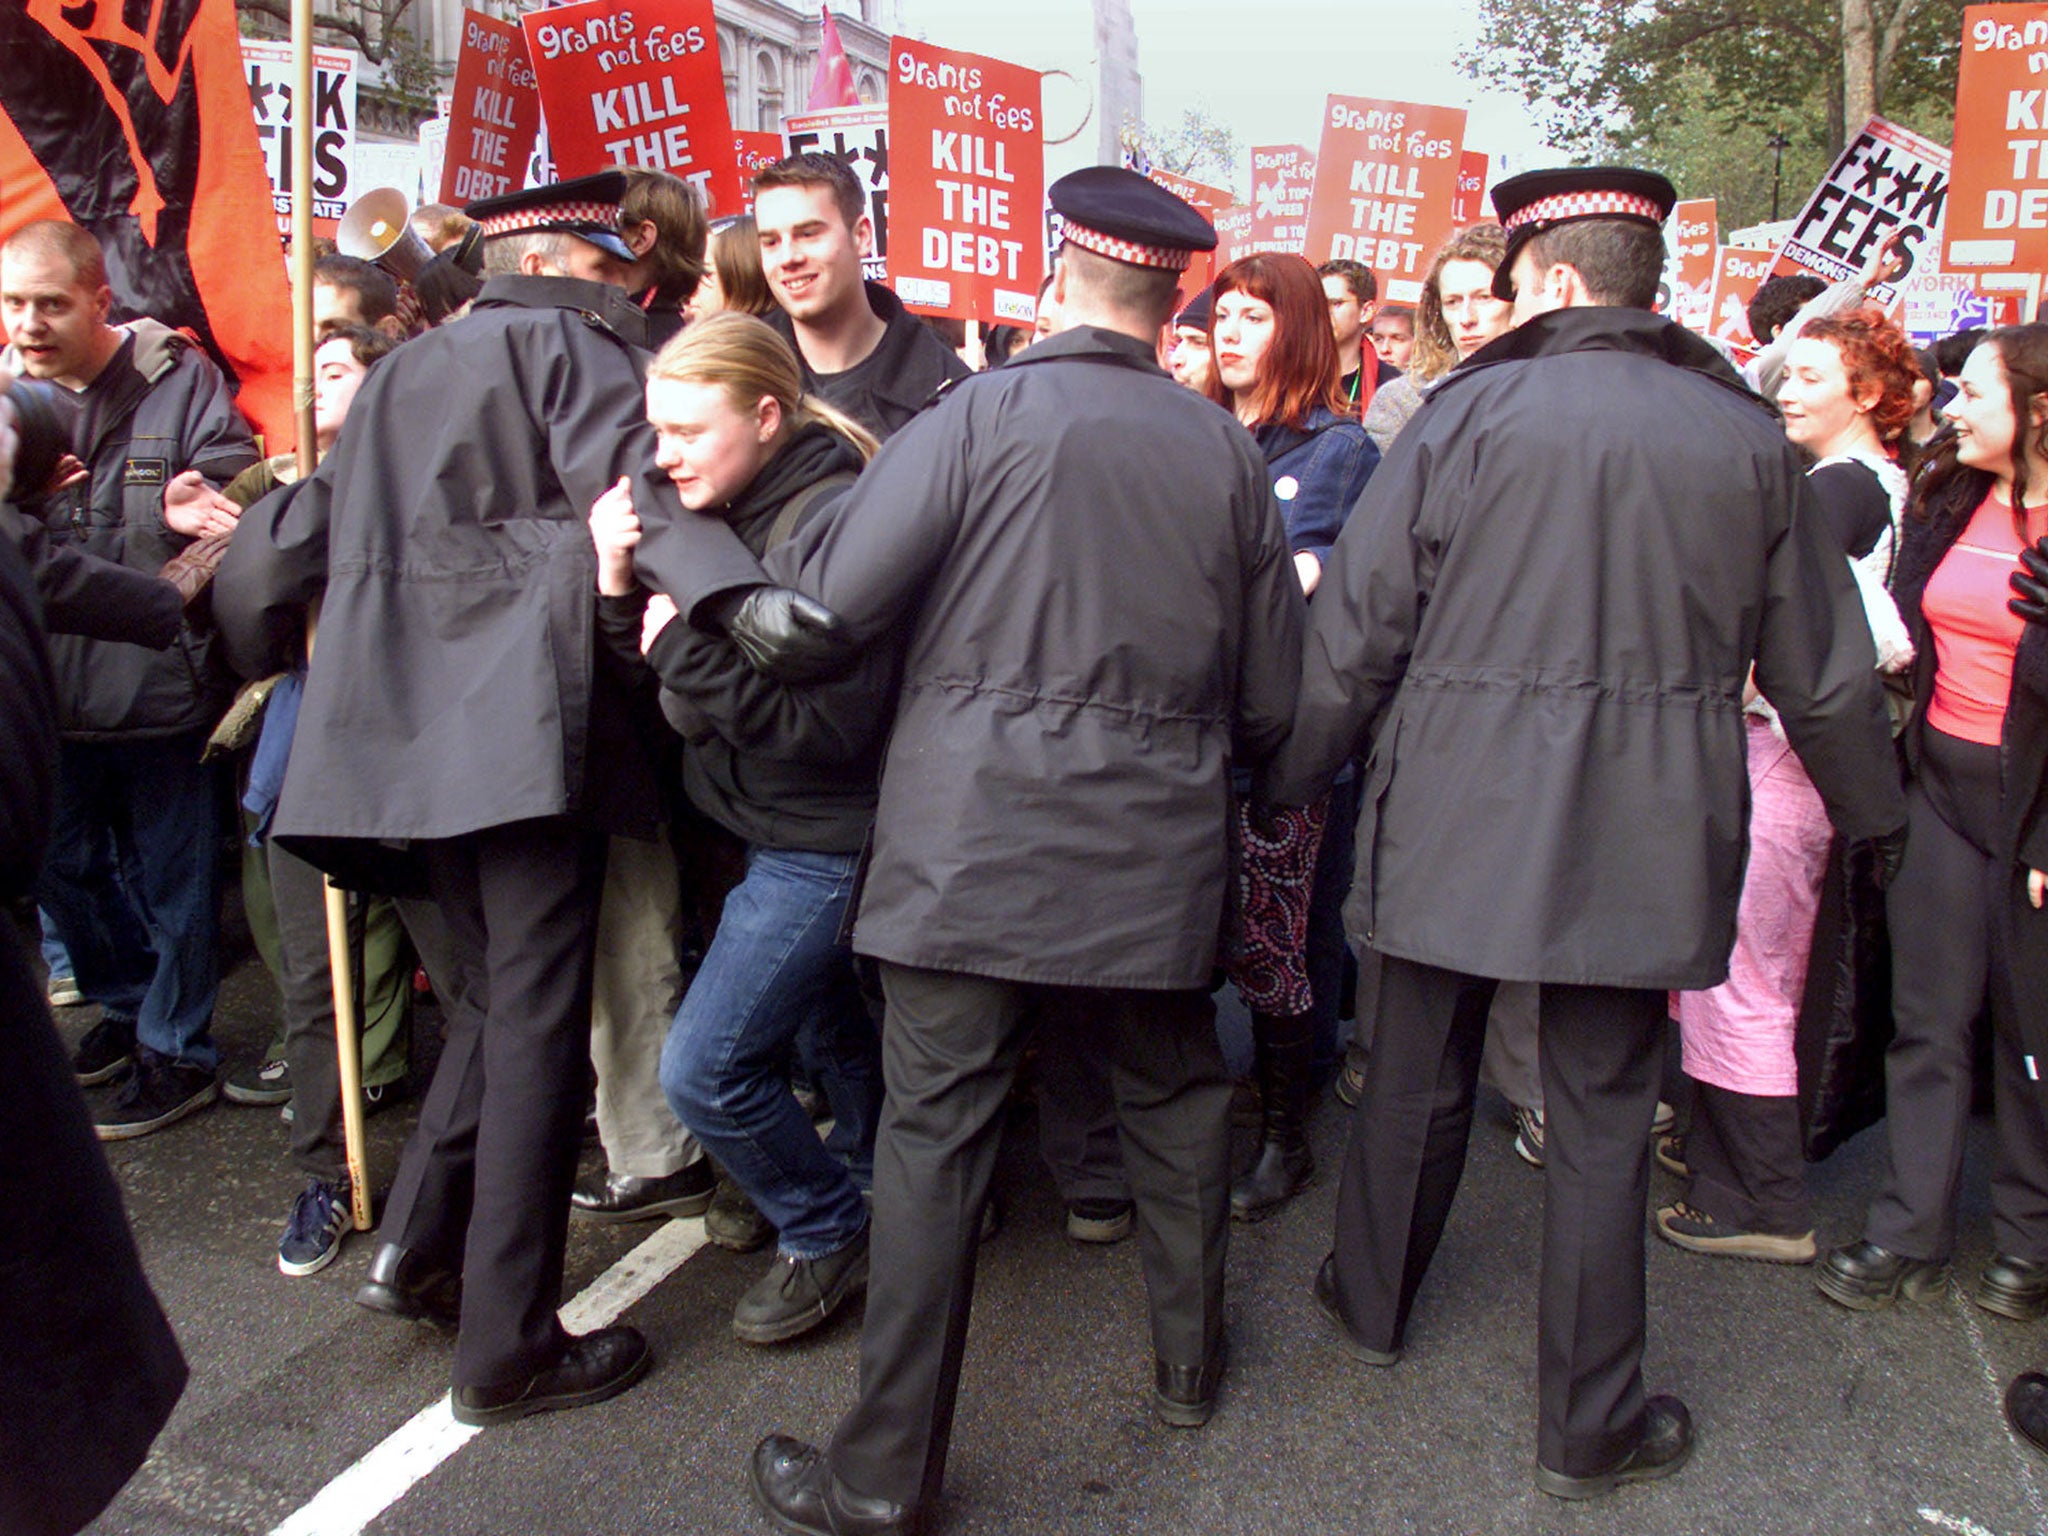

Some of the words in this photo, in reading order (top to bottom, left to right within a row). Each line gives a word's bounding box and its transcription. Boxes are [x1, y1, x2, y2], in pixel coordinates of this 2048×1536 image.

[467, 21, 510, 57] grants
[537, 11, 634, 59] grants
[597, 37, 642, 73] not
[644, 25, 705, 62] fees
[508, 57, 538, 90] fees
[898, 52, 982, 93] grants
[473, 86, 516, 129] KILL
[591, 75, 690, 134] KILL
[944, 93, 983, 120] not
[987, 93, 1034, 132] fees
[1332, 104, 1405, 132] grants
[471, 127, 510, 167] THE
[605, 125, 693, 171] THE
[932, 129, 1015, 183] KILL
[1368, 132, 1401, 153] not
[1406, 130, 1452, 159] fees
[454, 165, 511, 200] DEBT
[1350, 160, 1424, 198] KILL
[936, 179, 1010, 230] THE
[1351, 198, 1417, 235] THE
[923, 227, 1023, 280] DEBT
[1330, 233, 1424, 273] DEBT
